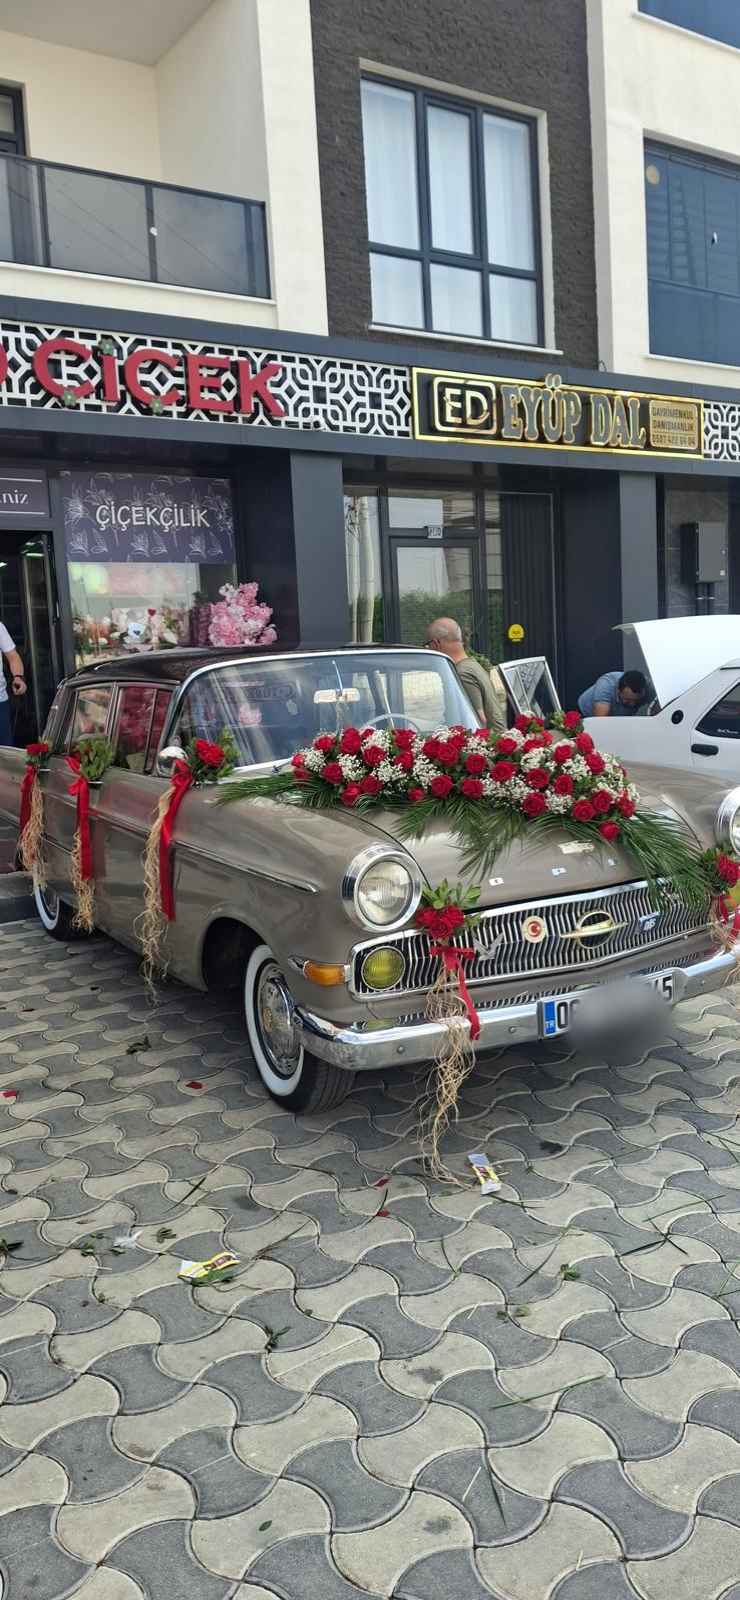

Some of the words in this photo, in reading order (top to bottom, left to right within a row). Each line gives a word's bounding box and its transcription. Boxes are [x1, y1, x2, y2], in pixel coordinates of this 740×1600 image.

[33, 338, 287, 417] ÇİÇEK
[444, 387, 489, 425] ED
[500, 373, 582, 443] EYÜP
[590, 393, 647, 449] DAL
[652, 407, 694, 419] GAYRİMENKUL
[652, 420, 694, 431] DANIŞMANLIK
[0, 489, 29, 504] niz
[96, 501, 210, 531] ÇİÇEKÇİLİK
[545, 1020, 555, 1029] TR
